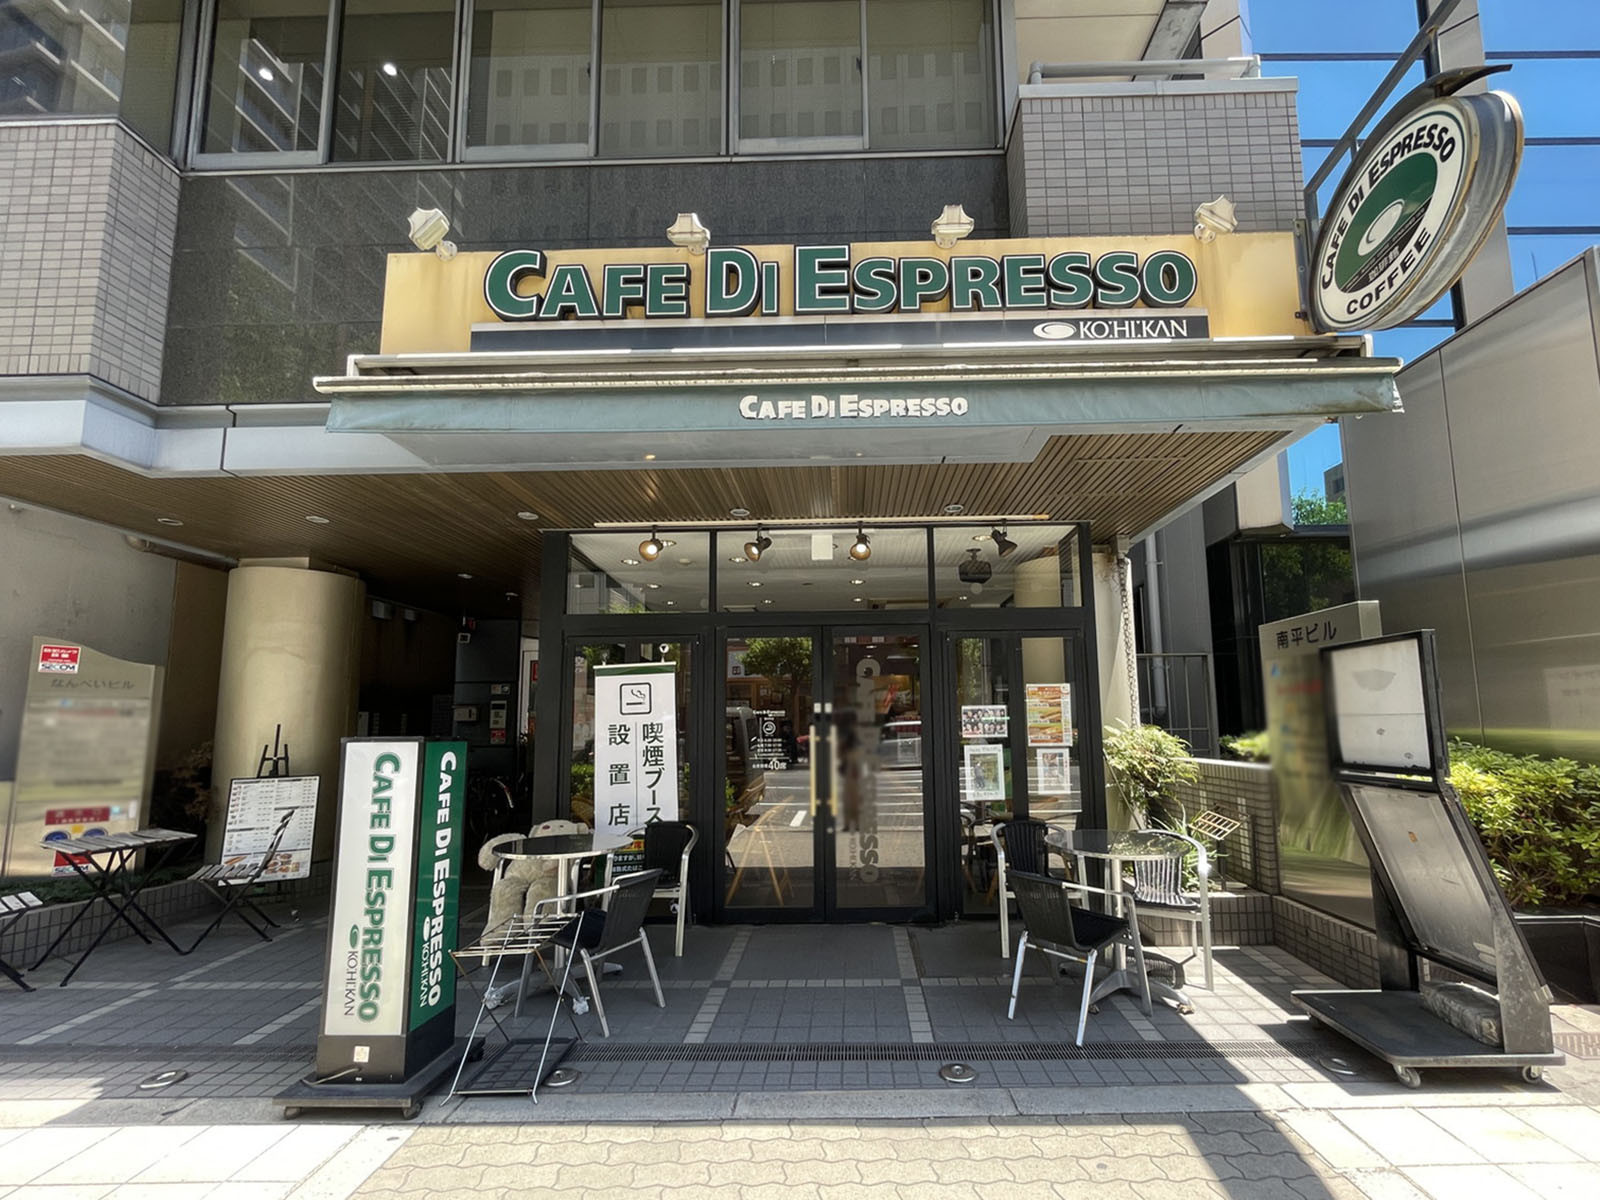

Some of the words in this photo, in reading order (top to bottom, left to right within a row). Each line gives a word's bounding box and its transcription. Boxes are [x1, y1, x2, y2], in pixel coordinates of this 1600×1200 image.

[1322, 217, 1348, 289] CAFE
[1348, 186, 1364, 216] DI
[1368, 124, 1456, 183] ESPRESSO
[484, 248, 691, 321] CAFE
[794, 245, 1197, 316] ESPRESSO
[1346, 228, 1431, 315] COFFEE
[740, 395, 806, 420] CAFE
[840, 394, 969, 419] ESPRESSO
[1276, 620, 1336, 649] 南平ビル
[369, 751, 401, 829] CAFE
[436, 750, 457, 824] CAFE
[608, 724, 631, 826] 設置店
[642, 722, 665, 824] 喫煙ブース
[357, 867, 394, 1022] ESPRESSO
[428, 859, 449, 1006] ESPRESSO
